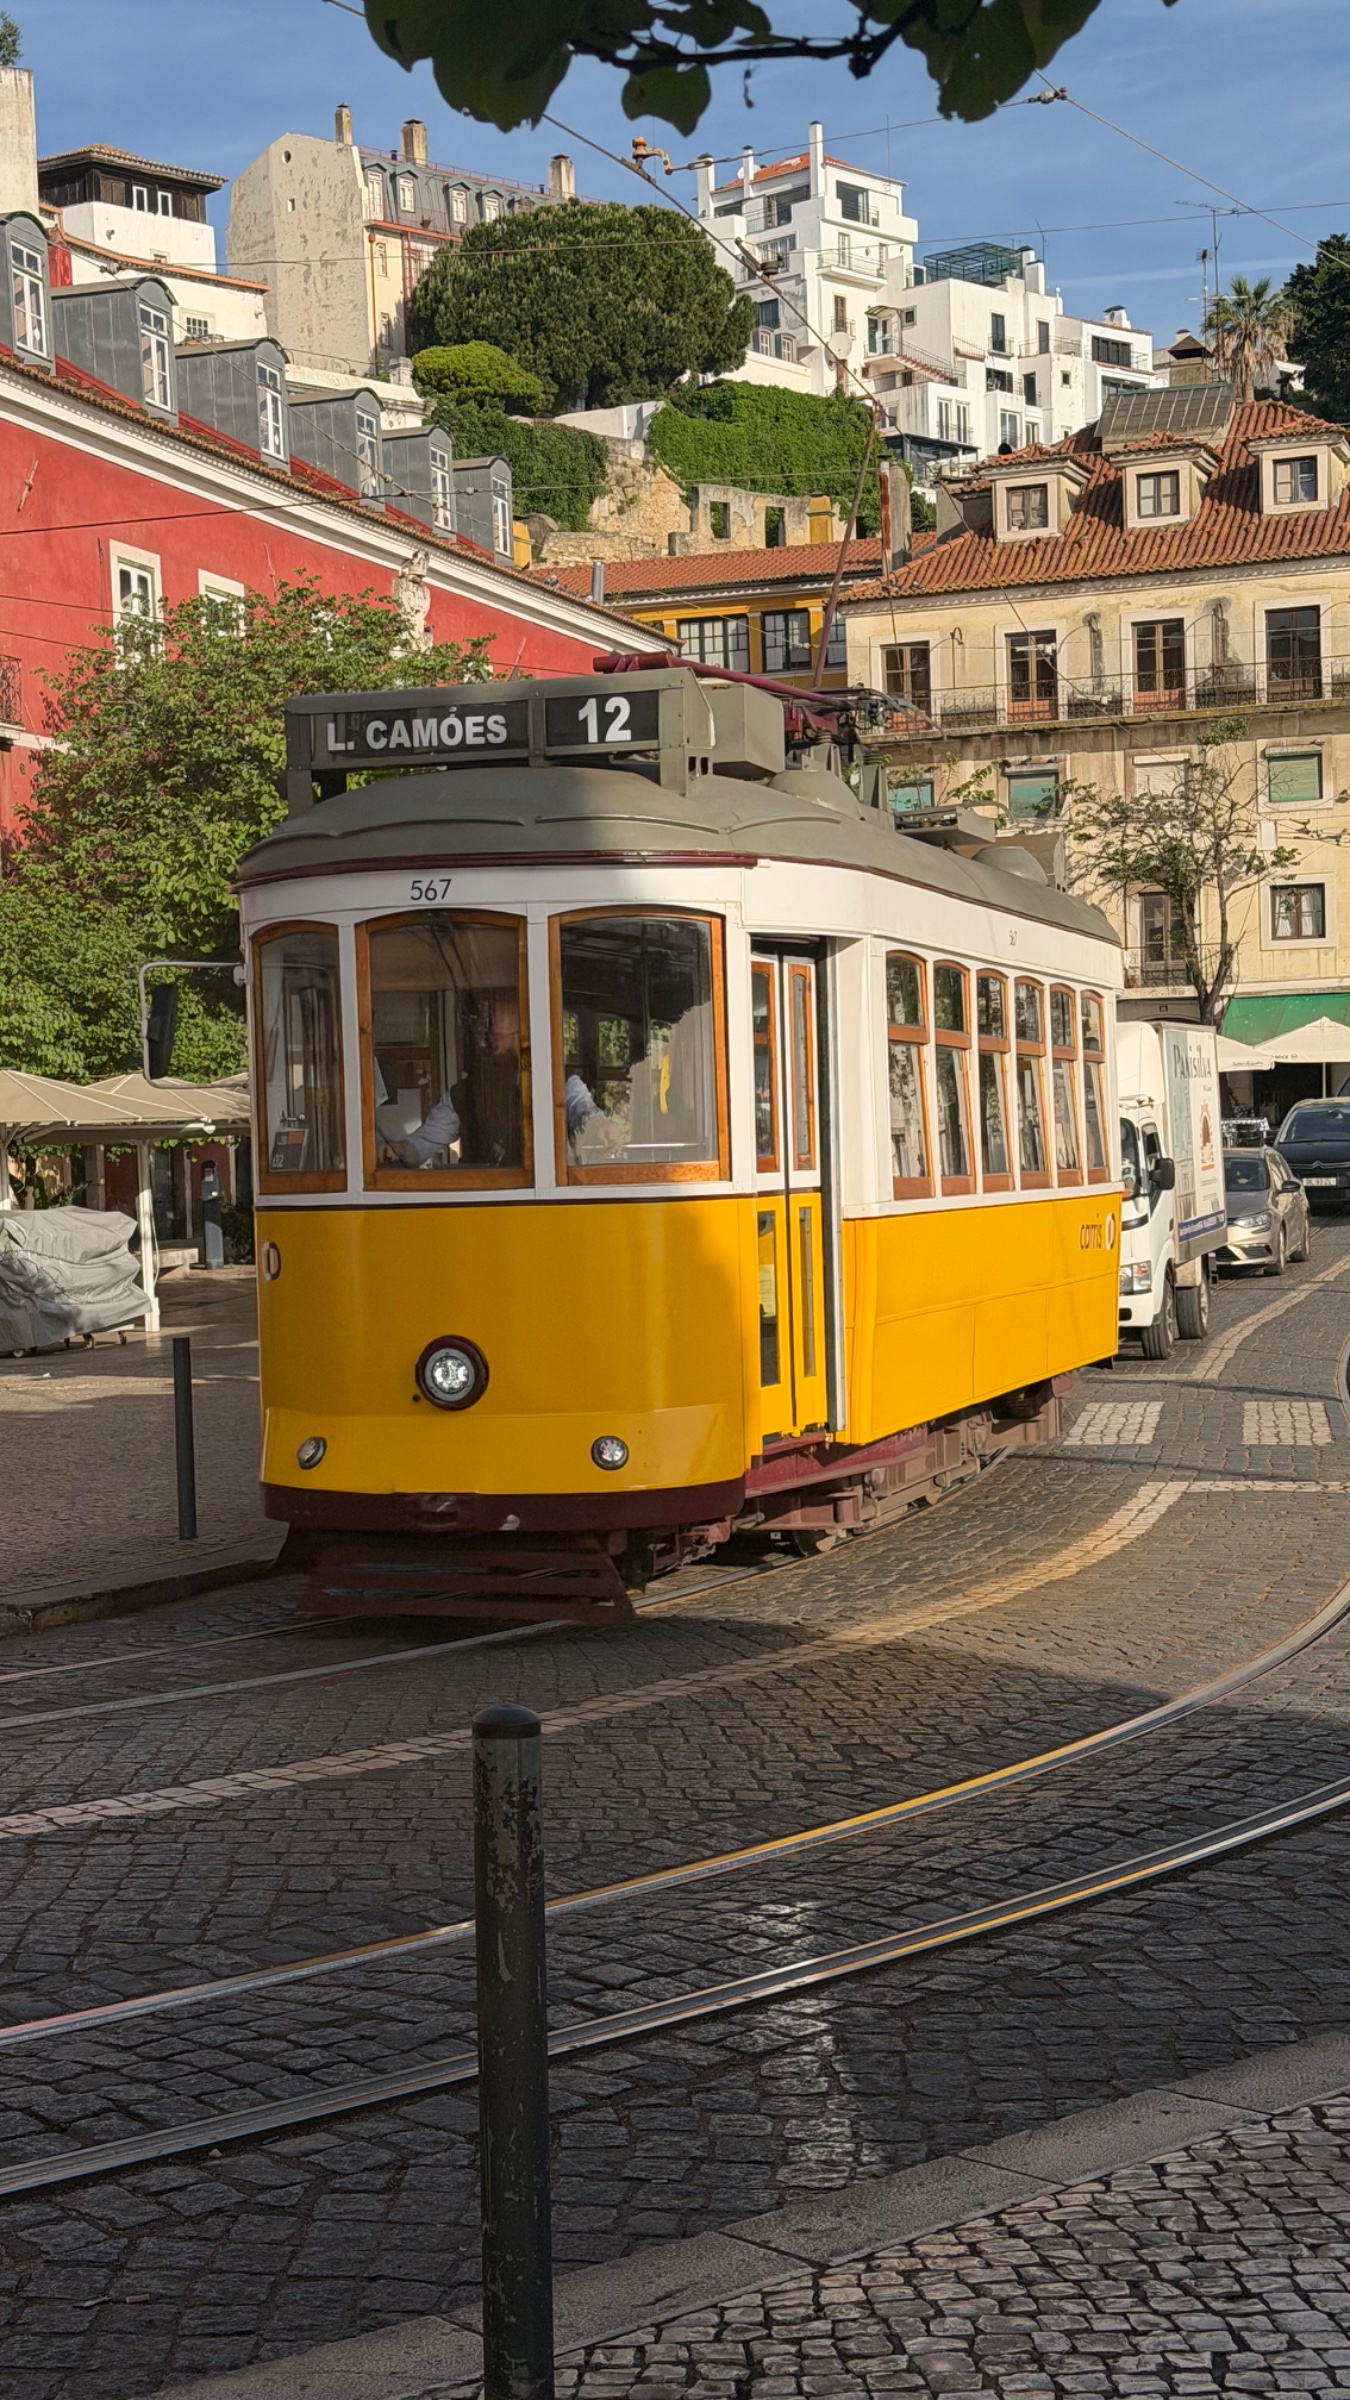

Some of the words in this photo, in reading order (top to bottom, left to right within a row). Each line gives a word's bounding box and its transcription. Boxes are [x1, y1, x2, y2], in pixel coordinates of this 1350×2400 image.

[578, 696, 632, 743] 12
[327, 722, 355, 751] L.
[410, 878, 452, 902] 567
